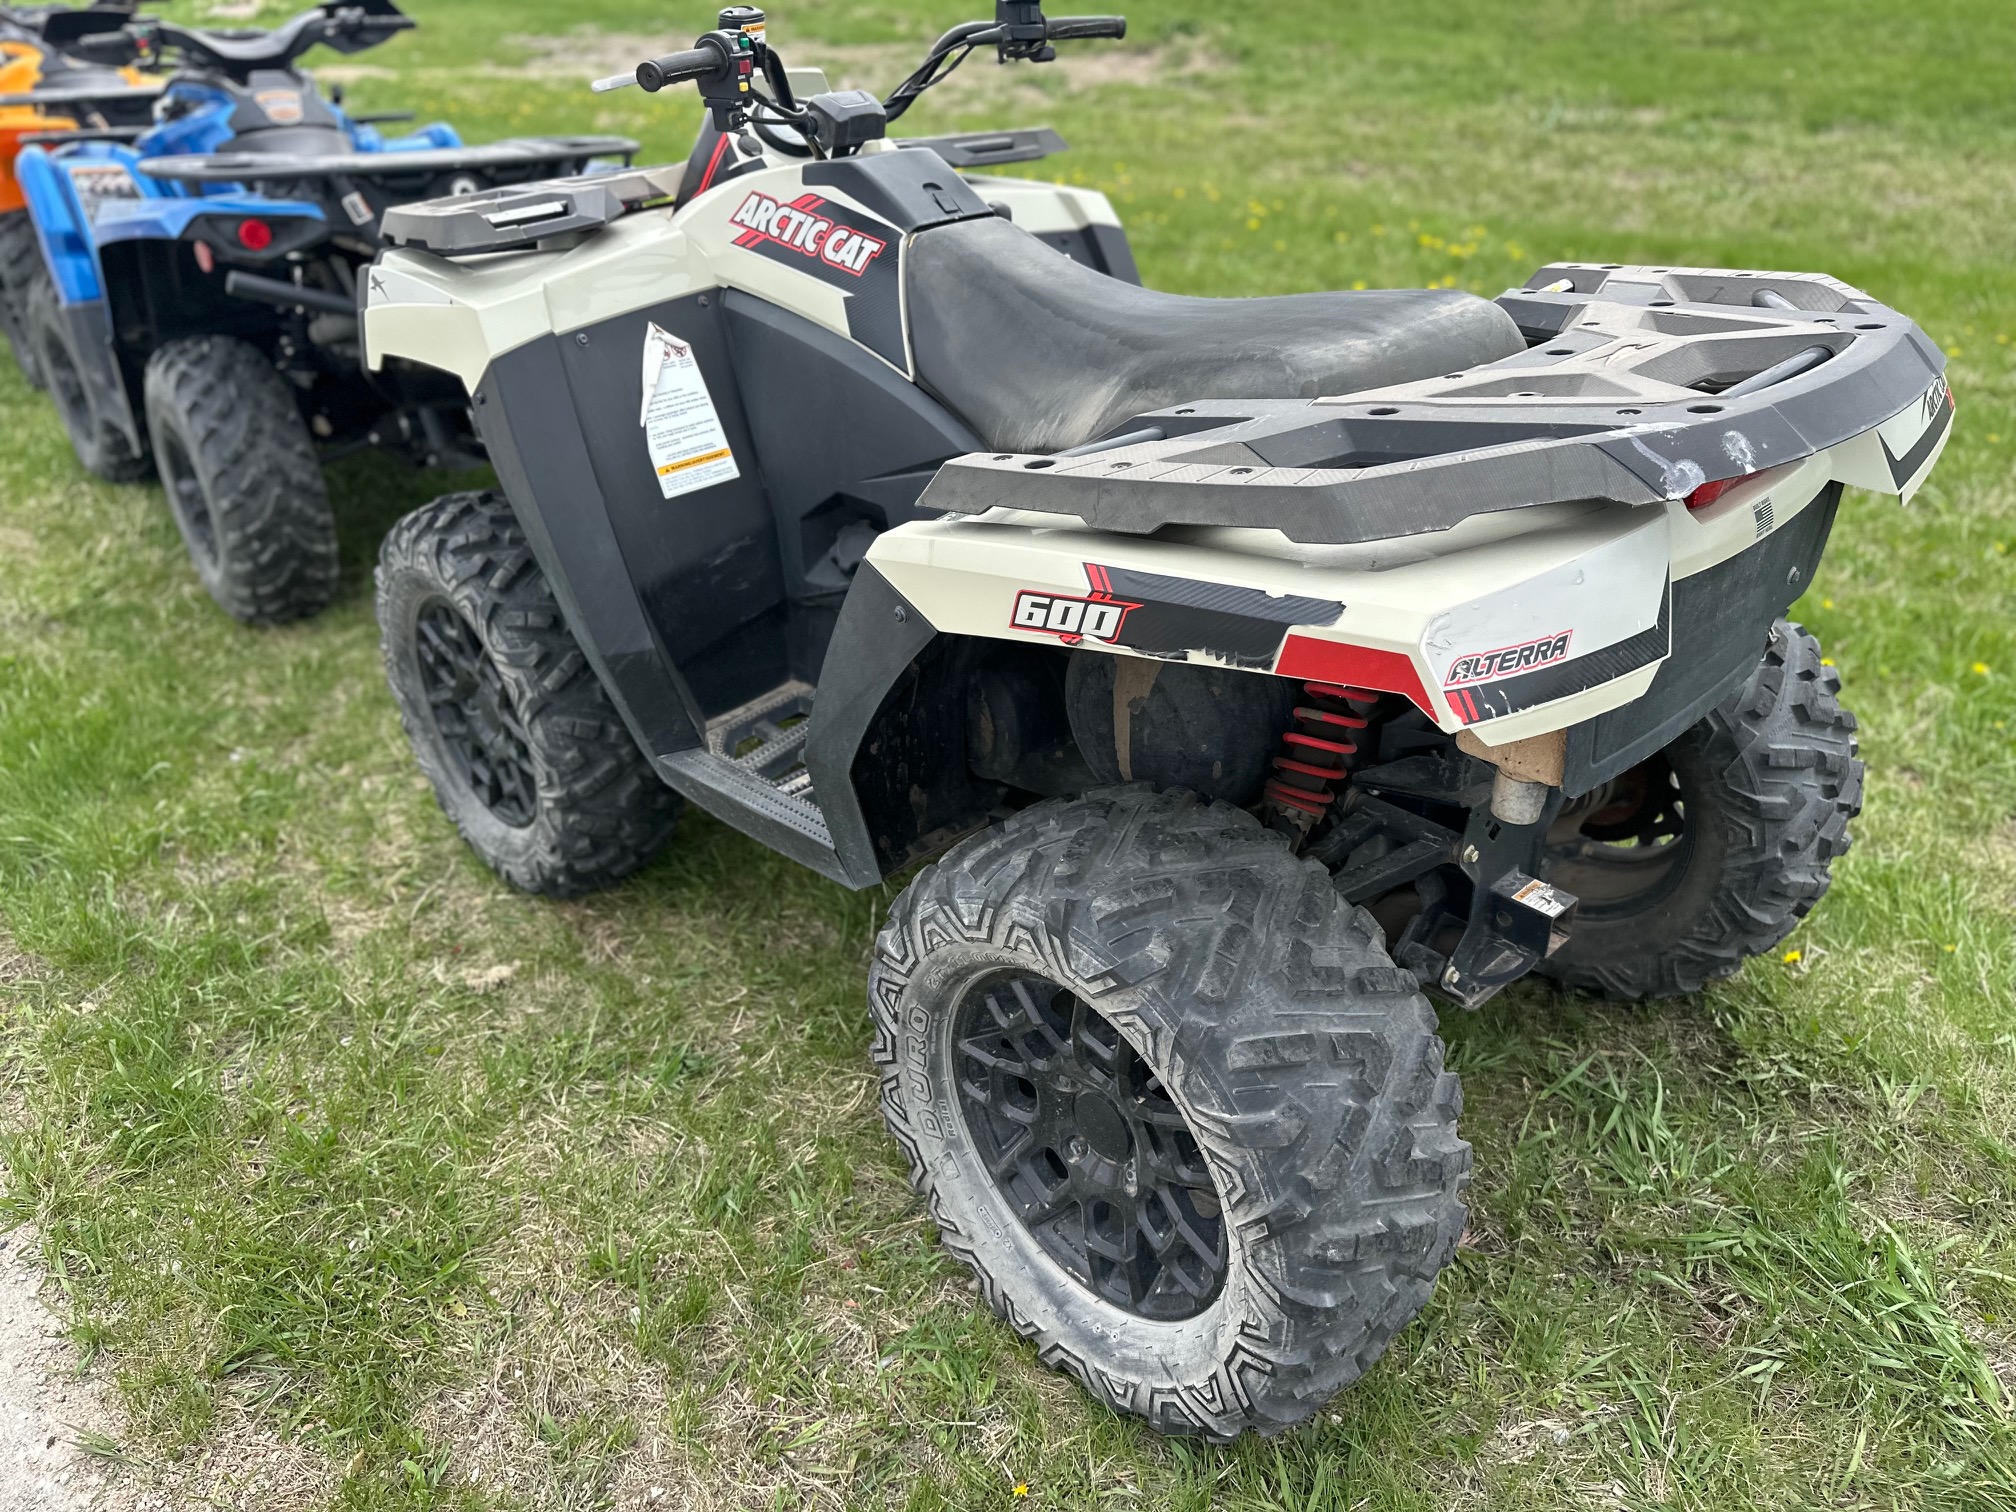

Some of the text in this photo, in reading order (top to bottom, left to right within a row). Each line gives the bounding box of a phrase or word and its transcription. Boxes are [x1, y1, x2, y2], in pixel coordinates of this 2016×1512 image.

[733, 193, 881, 271] ARCTIC CAT
[1013, 594, 1123, 638] 600
[1449, 634, 1570, 682] ALTERRA
[907, 1004, 942, 1140] DURO
[942, 1100, 956, 1138] Radial
